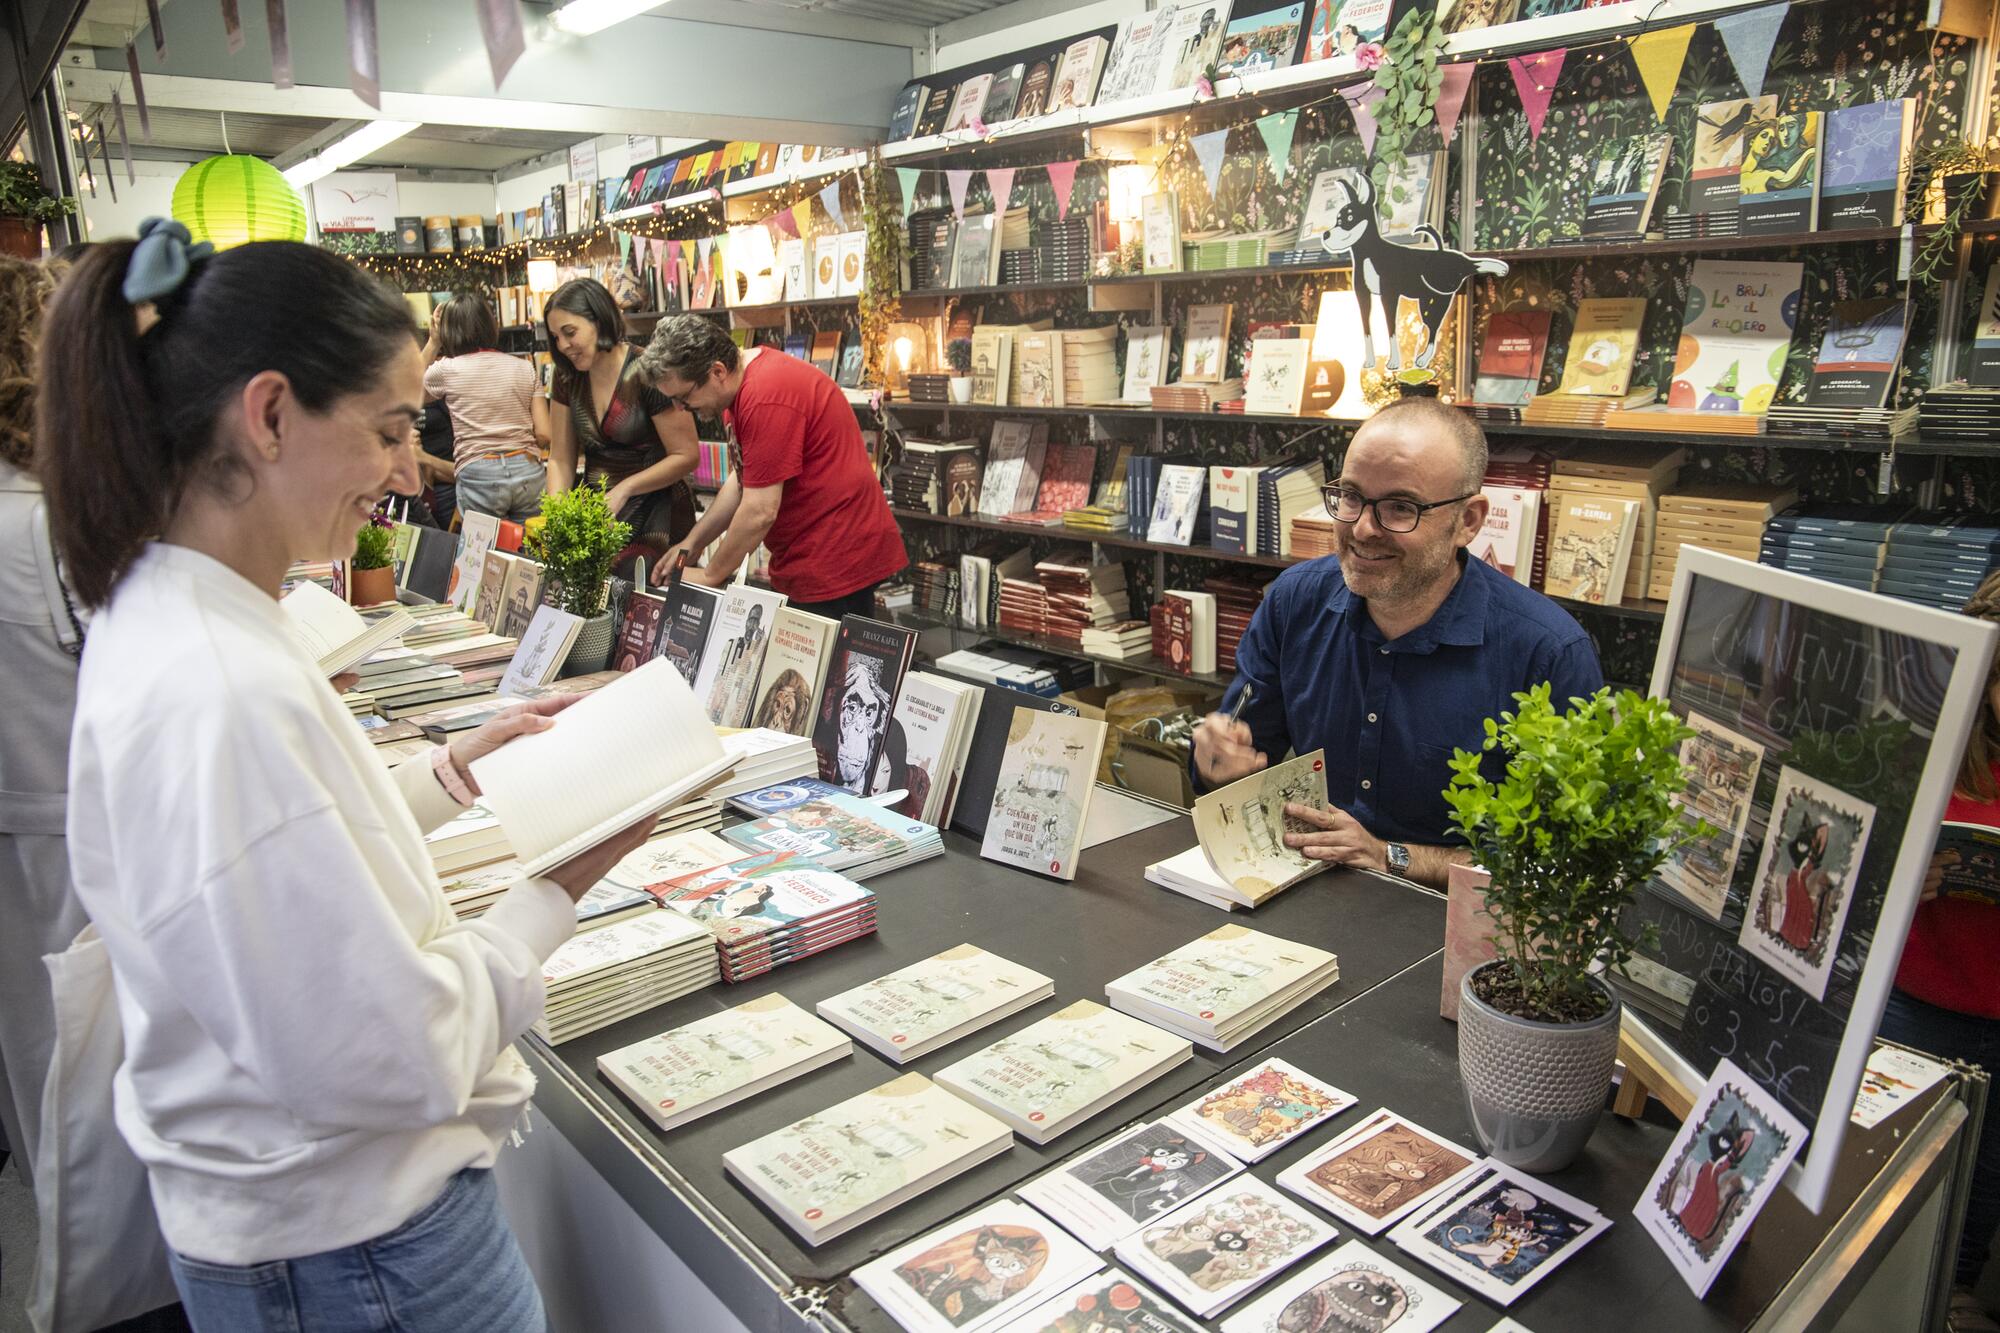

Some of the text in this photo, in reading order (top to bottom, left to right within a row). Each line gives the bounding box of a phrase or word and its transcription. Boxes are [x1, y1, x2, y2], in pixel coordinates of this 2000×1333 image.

[1350, 3, 1385, 17] FEDERICO
[1712, 283, 1774, 308] LA BRUJA
[1744, 301, 1758, 313] EL
[1491, 507, 1508, 518] CASA
[726, 604, 732, 613] DE
[732, 597, 745, 607] EL REY
[862, 630, 880, 643] FRANZ
[880, 634, 899, 648] KAFKA
[1006, 807, 1038, 823] CUENTAN DE
[1013, 820, 1036, 833] UN VIEJO
[1004, 828, 1033, 843] QUE UN DÍA
[1001, 845, 1013, 855] JORGE
[1018, 850, 1030, 859] ORTIZ
[784, 879, 830, 905] FEDERICO
[1166, 968, 1196, 981] CUENTAN
[1178, 981, 1200, 990] VIEJO
[880, 989, 908, 1003] CUENTAN
[887, 1002, 906, 1012] VIEJO
[1002, 1055, 1047, 1078] CUENTAN DE
[999, 1074, 1011, 1083] UN
[1002, 1066, 1036, 1083] UN VIEJO
[800, 1137, 842, 1166] CUENTAN DE
[773, 1152, 794, 1165] QUE
[789, 1161, 803, 1171] UN
[796, 1150, 829, 1173] UN VIEJO
[1142, 1314, 1172, 1333] Derry
